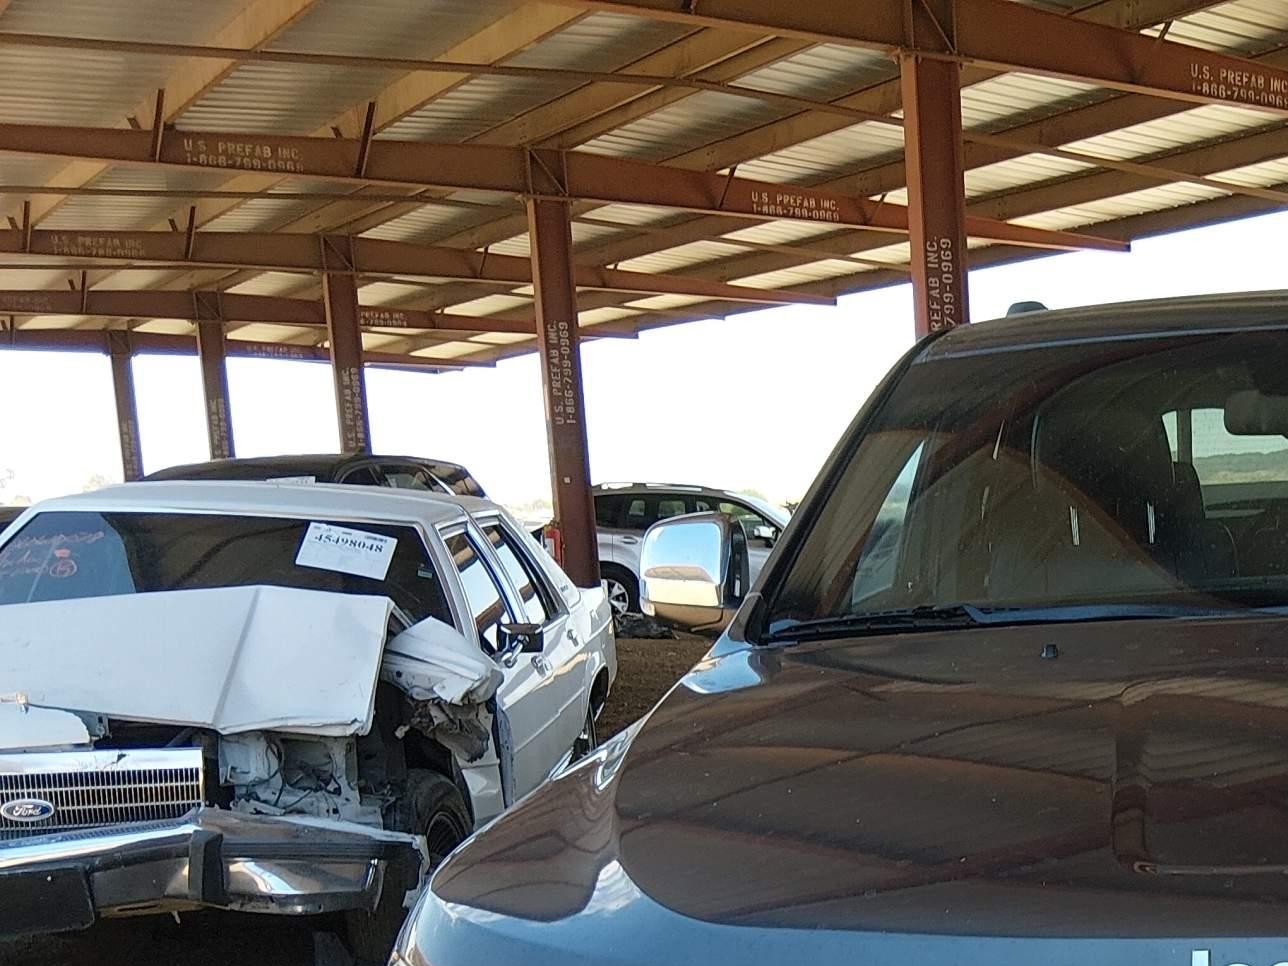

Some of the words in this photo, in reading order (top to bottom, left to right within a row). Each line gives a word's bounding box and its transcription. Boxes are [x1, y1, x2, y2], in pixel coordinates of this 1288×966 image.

[1191, 63, 1213, 80] U.S.
[1220, 68, 1265, 88] PREFAB
[218, 142, 272, 158] PREFAB
[776, 193, 816, 209] PREFAB
[820, 199, 840, 211] INC.
[926, 236, 939, 268] INC.
[547, 320, 559, 344] INC.
[549, 349, 562, 396] PREFAB
[559, 321, 577, 424] 1-866-799-0969
[554, 402, 565, 425] U.S.
[314, 533, 384, 553] 45498048
[13, 804, 42, 816] Ford
